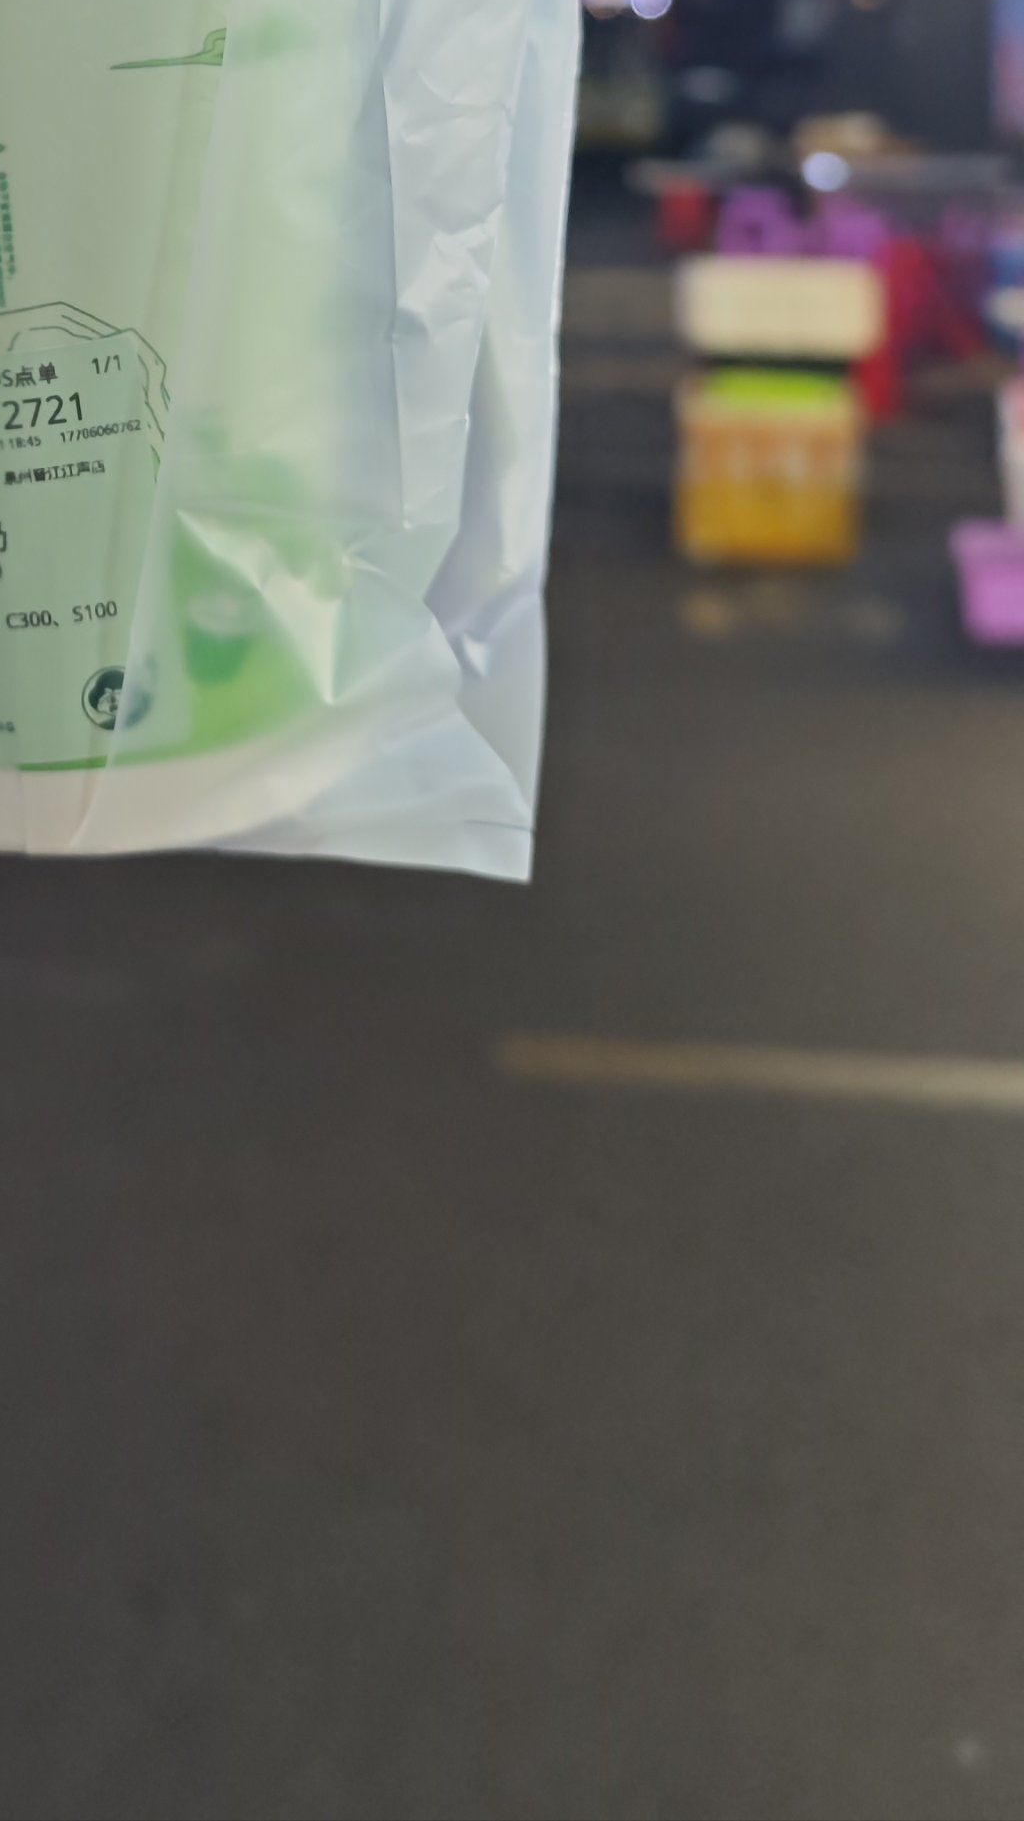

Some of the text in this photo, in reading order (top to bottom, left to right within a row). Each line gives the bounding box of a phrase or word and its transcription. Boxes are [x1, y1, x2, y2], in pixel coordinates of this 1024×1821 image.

[91, 354, 122, 375] 1/1
[1, 392, 84, 430] 2721
[72, 600, 118, 623] S100
